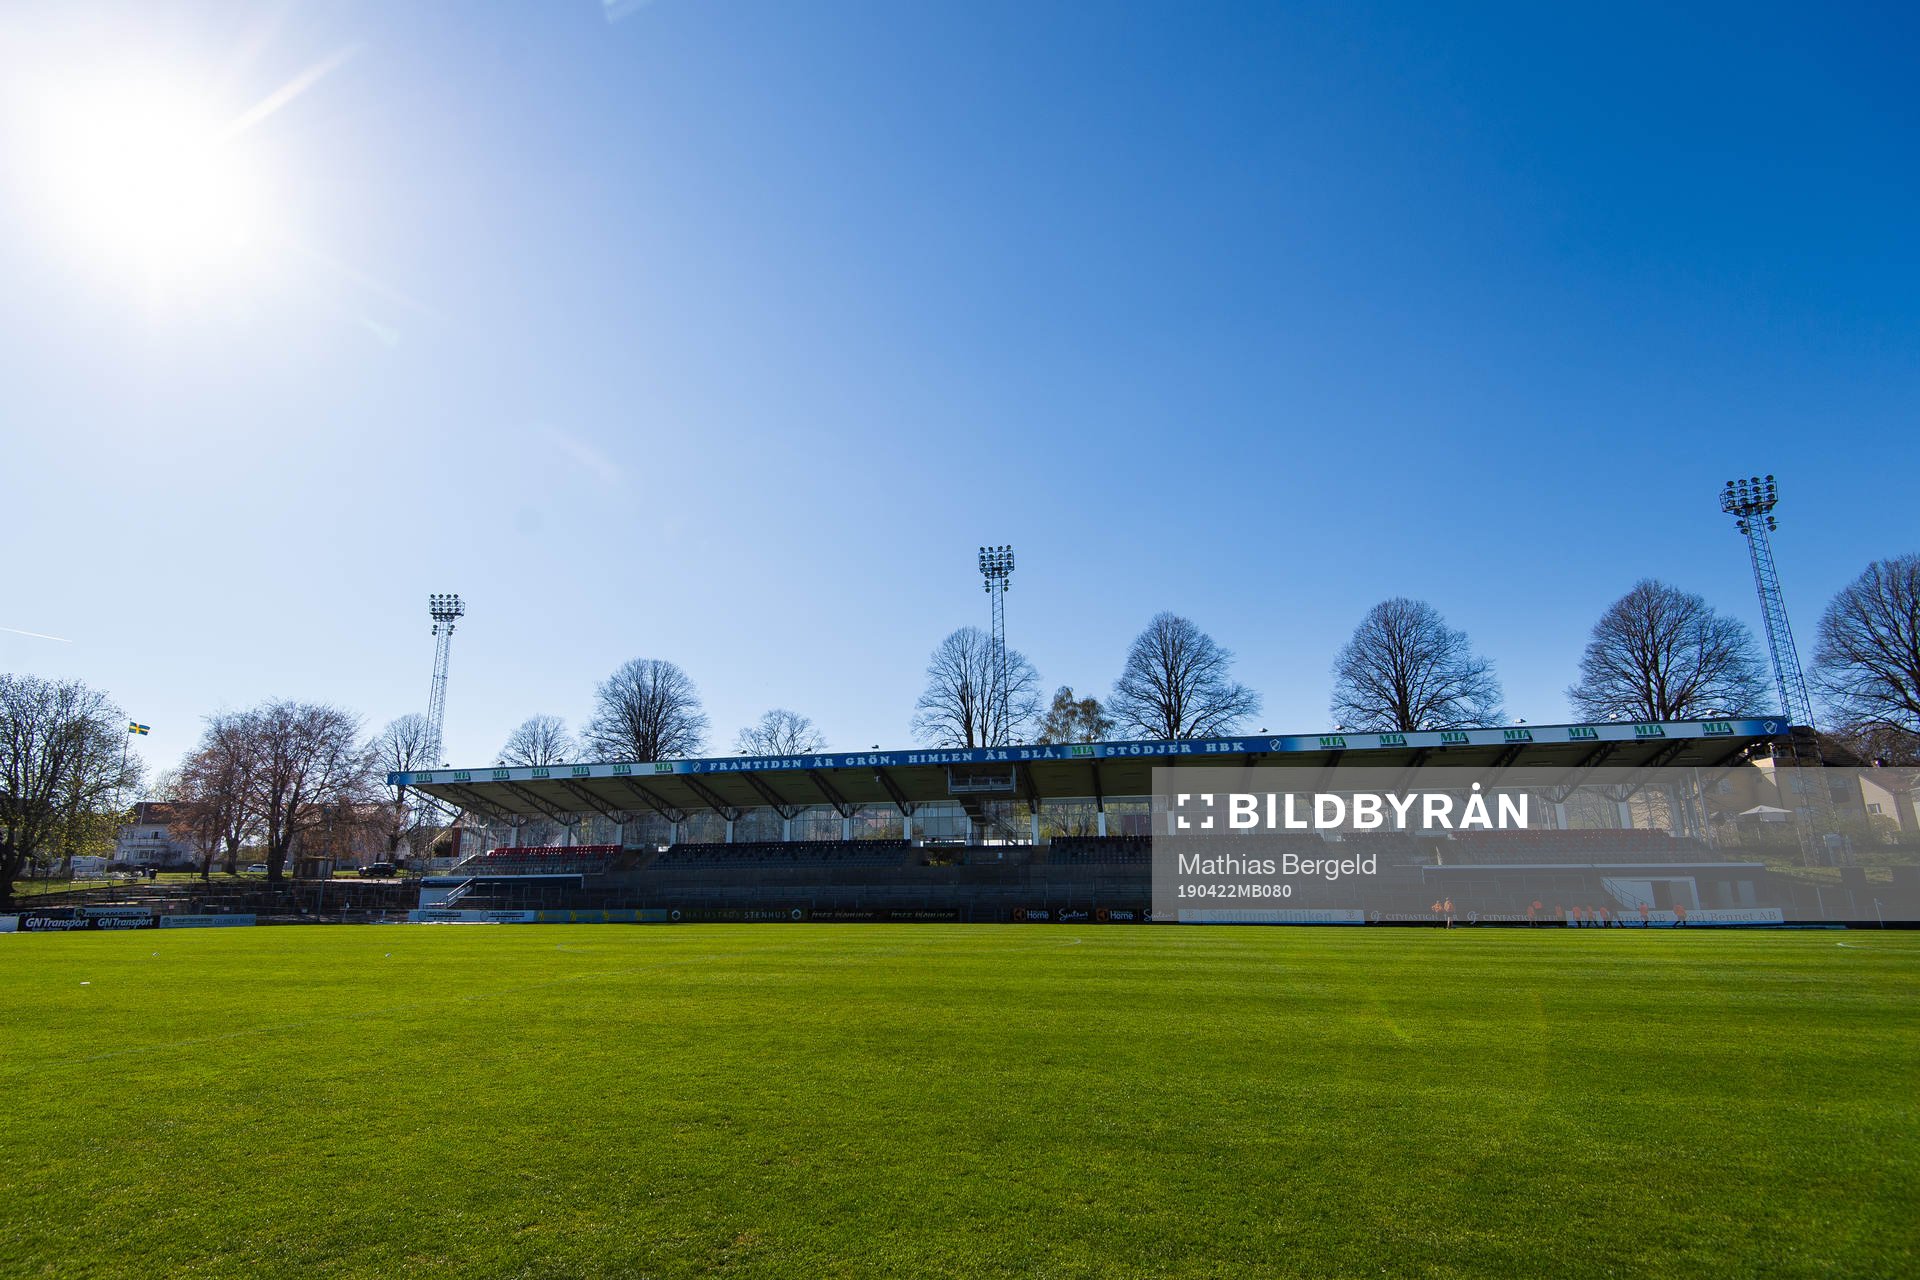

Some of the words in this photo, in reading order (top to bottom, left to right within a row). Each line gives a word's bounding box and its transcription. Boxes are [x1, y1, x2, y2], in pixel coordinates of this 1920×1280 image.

[1568, 728, 1596, 737] MTA
[1634, 725, 1664, 735] MTA
[1702, 722, 1733, 733] MTA
[1379, 734, 1407, 744] MTA
[1440, 732, 1468, 742] MTA
[1504, 730, 1532, 739] MTA
[1319, 736, 1346, 746] MTA
[1072, 745, 1095, 755] MTA
[1106, 742, 1192, 755] STÖDJER
[1206, 742, 1245, 752] HBK
[709, 759, 801, 771] FRAMTIDEN
[813, 756, 834, 767] ÄR
[845, 754, 897, 766] GRÖN,
[908, 752, 973, 764] HIMLEN
[985, 749, 1008, 761] ÄR
[1020, 745, 1061, 759] BLÅ,
[744, 911, 787, 919] STENHUS
[1209, 909, 1333, 922] Söndrumskliniken
[1711, 911, 1753, 922] Bennet
[1759, 910, 1777, 921] AB
